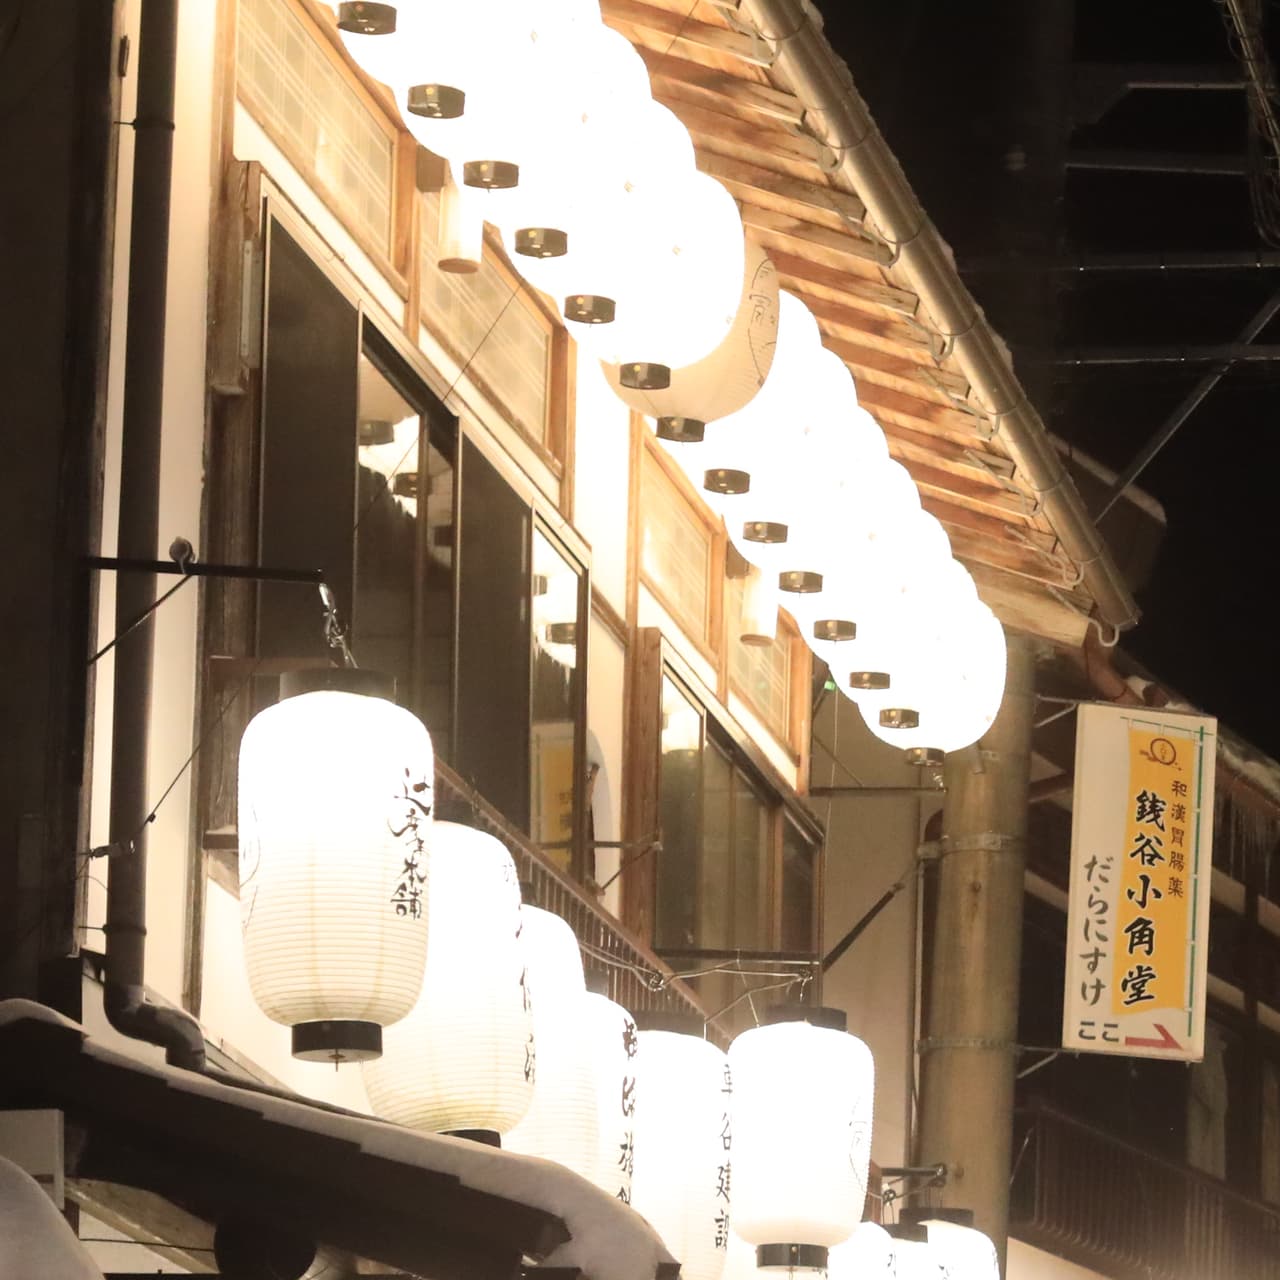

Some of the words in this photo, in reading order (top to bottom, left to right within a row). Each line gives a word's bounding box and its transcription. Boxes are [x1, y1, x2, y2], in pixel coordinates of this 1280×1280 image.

[1121, 789, 1167, 1005] 銭谷小角堂
[1168, 780, 1188, 898] 和漢胃腸薬
[1080, 855, 1114, 1006] だらにすけ
[1078, 1021, 1120, 1042] ここ
